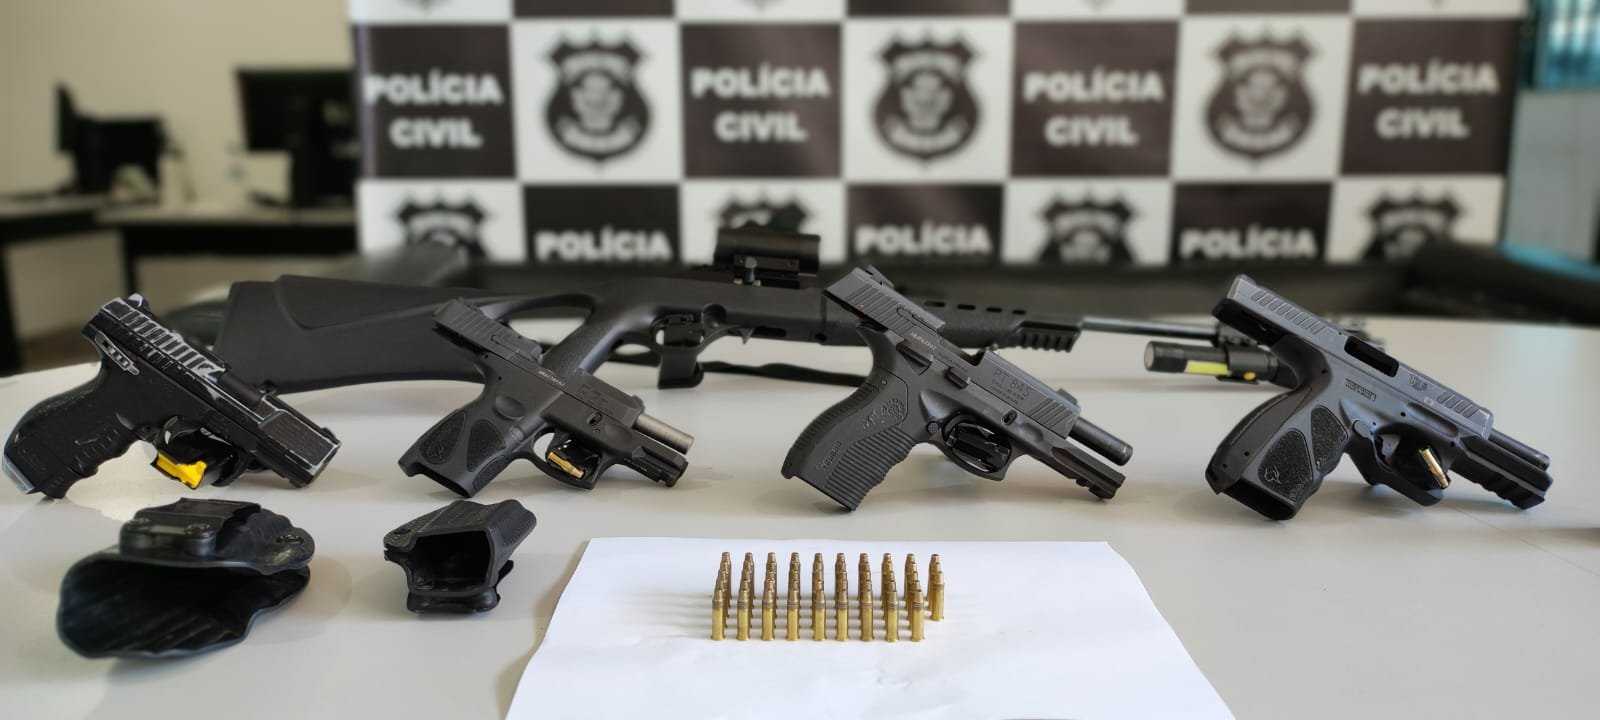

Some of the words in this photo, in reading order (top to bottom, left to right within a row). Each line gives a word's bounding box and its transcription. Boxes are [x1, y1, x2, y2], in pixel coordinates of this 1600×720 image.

[364, 69, 502, 105] POLÍCIA
[691, 63, 832, 98] POLÍCIA
[1023, 65, 1164, 102] POLÍCIA
[1358, 59, 1498, 95] POLÍCIA
[389, 117, 482, 148] CIVIL
[714, 111, 810, 142] CIVIL
[1044, 115, 1139, 146] CIVIL
[1376, 108, 1469, 139] CIVIL
[535, 227, 672, 261] POLÍCIA
[855, 222, 992, 255] POLÍCIA
[1181, 226, 1316, 259] POLÍCIA
